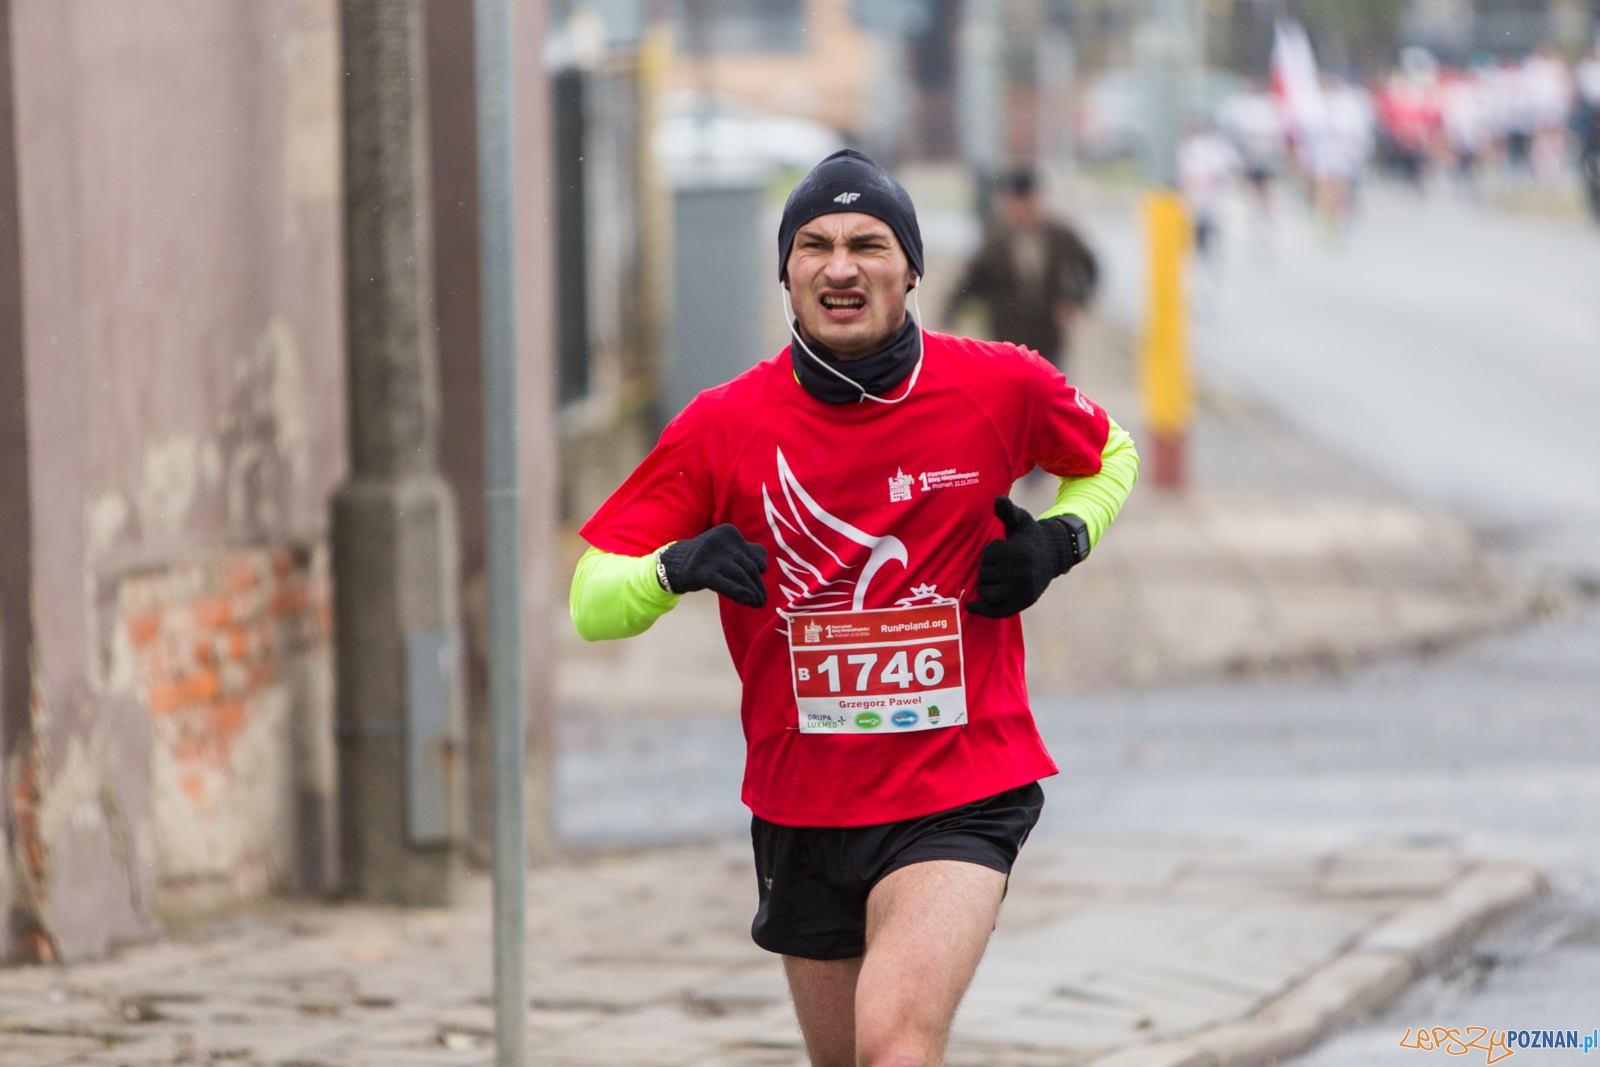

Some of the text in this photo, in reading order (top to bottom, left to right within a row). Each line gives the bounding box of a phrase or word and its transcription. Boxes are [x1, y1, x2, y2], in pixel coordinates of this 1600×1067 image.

[833, 192, 861, 204] 4F
[918, 472, 931, 491] 1
[825, 625, 833, 638] 1
[881, 619, 947, 633] RunPoland.org
[797, 667, 811, 681] B
[817, 647, 945, 692] 1746
[839, 696, 922, 709] Grzegorz Paweł
